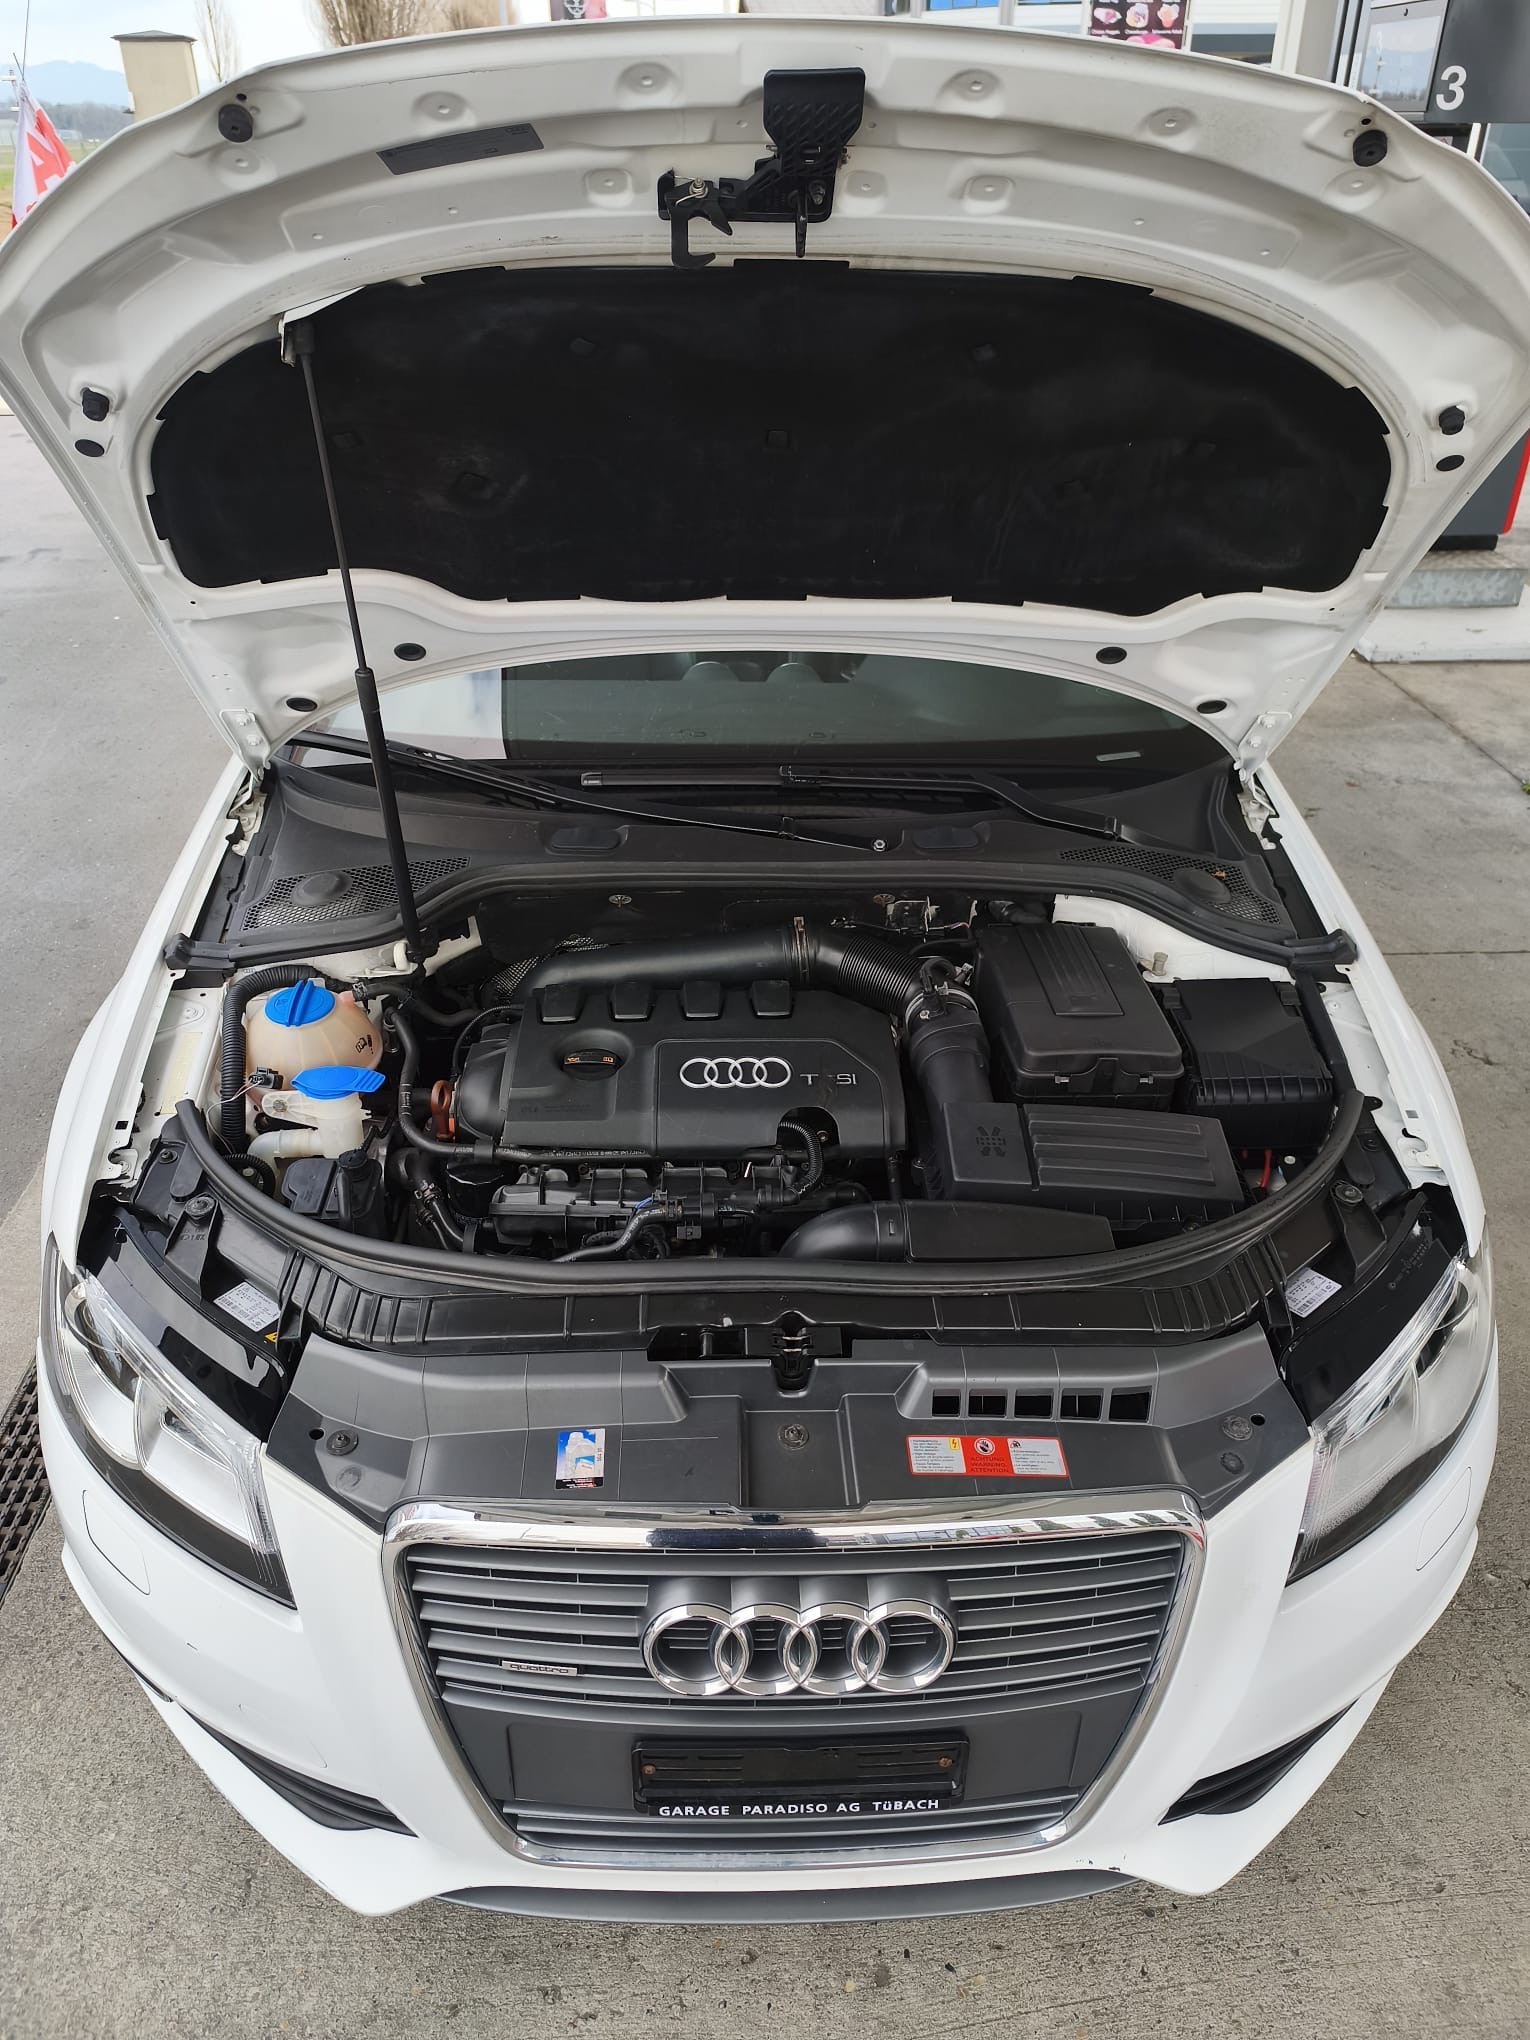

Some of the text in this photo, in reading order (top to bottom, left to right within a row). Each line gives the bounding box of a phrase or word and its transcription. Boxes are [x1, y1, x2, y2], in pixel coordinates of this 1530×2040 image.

[1436, 65, 1467, 111] 3
[510, 1664, 568, 1673] quattro
[659, 1806, 730, 1816] GARAGE
[742, 1803, 828, 1815] PARADISO
[836, 1802, 860, 1813] AG
